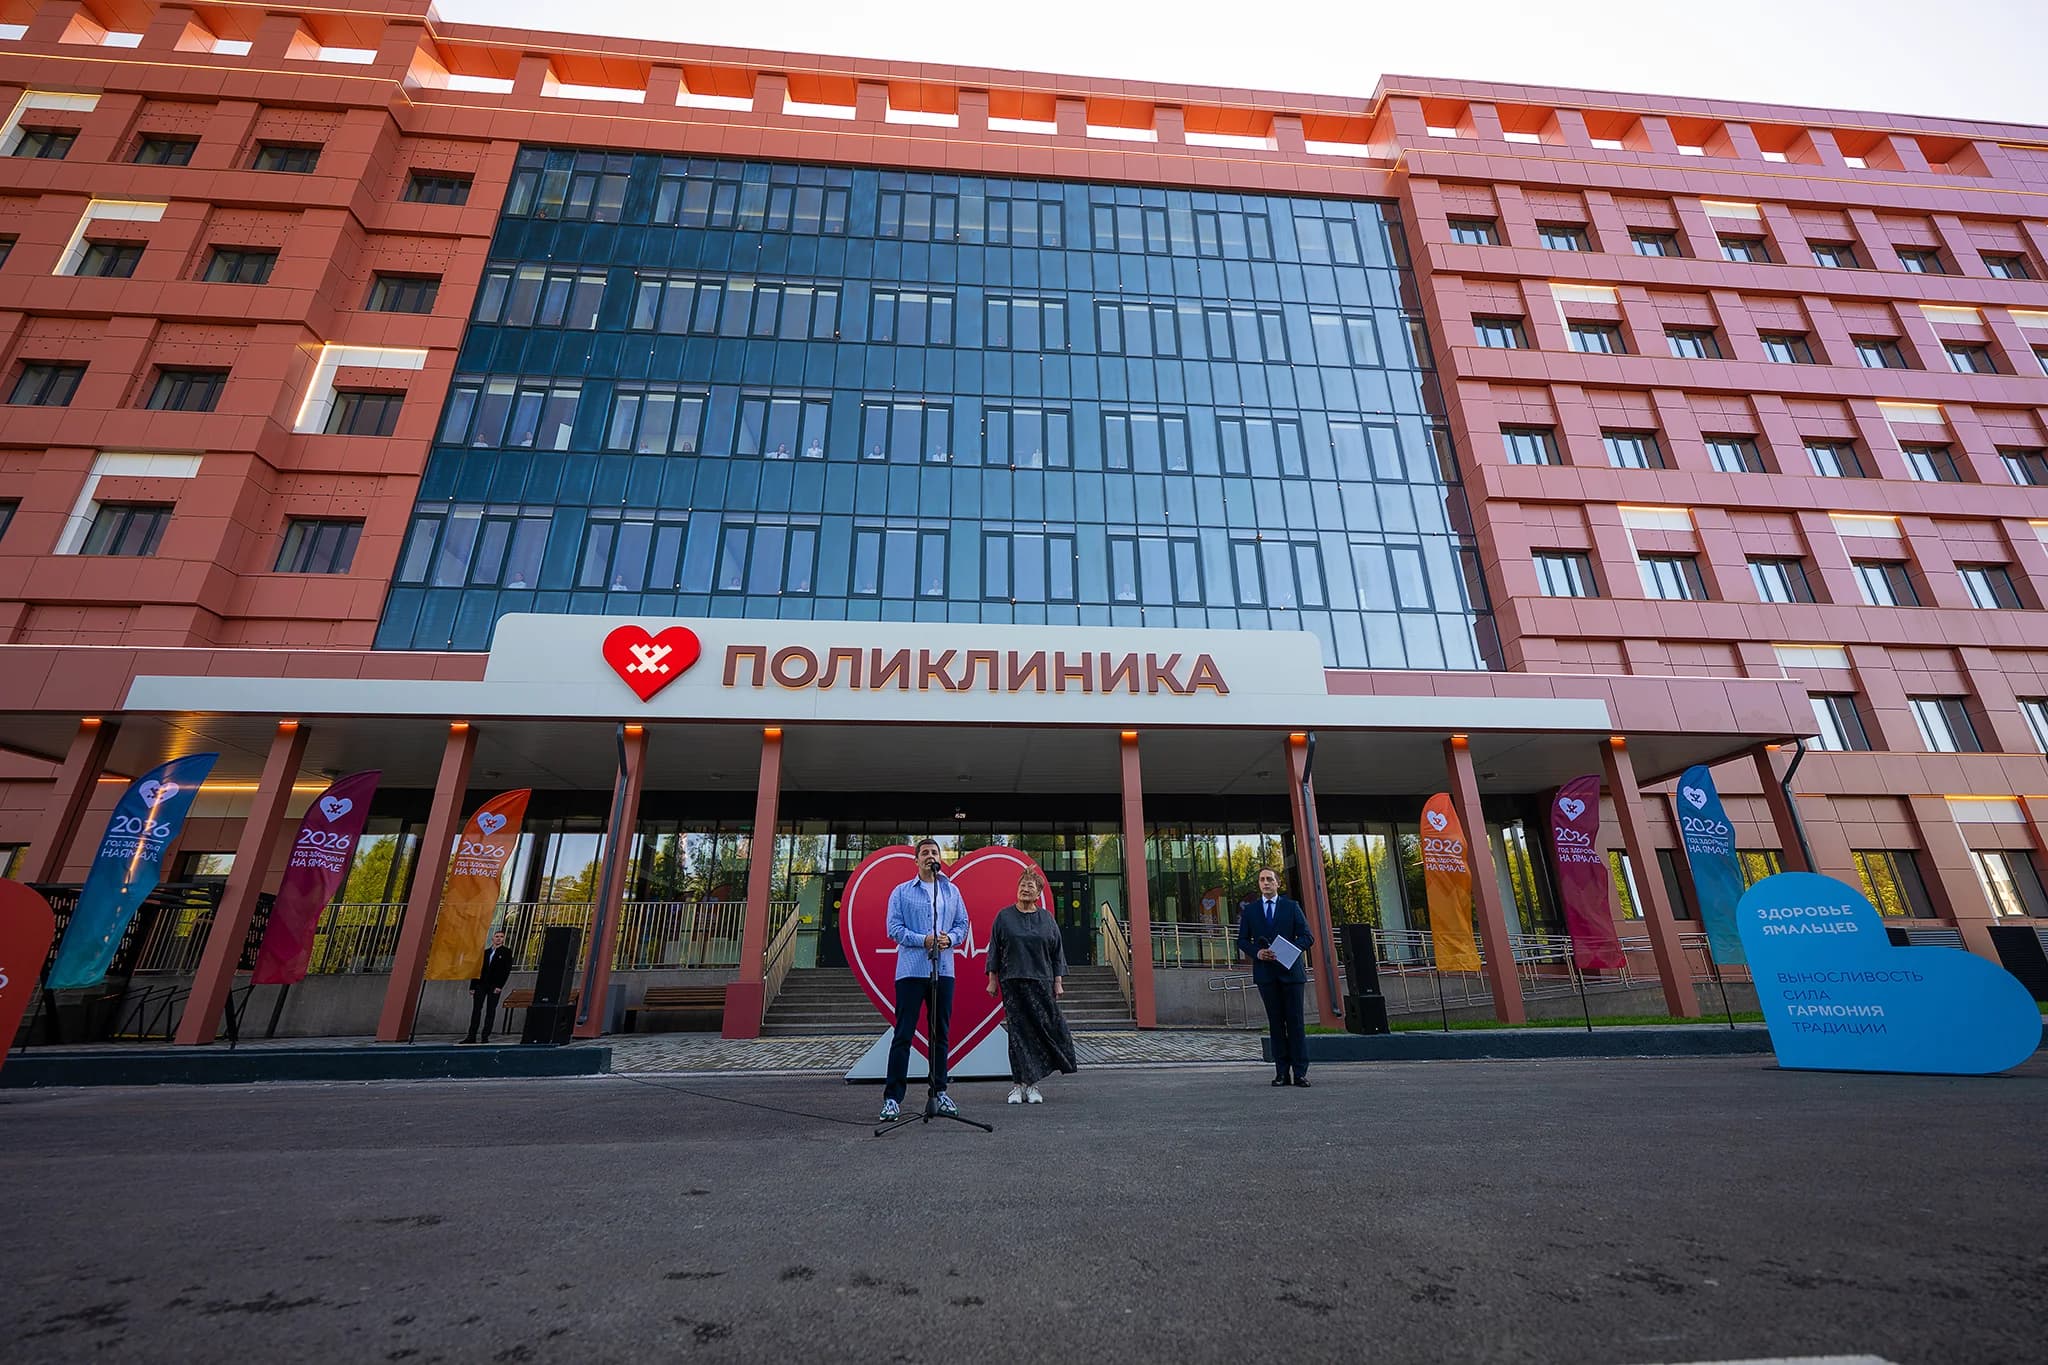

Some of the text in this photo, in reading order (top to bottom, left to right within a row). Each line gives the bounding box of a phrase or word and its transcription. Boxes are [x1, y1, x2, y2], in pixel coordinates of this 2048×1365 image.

[721, 645, 1230, 695] ПОЛИКЛИНИКА
[110, 815, 171, 838] 2026
[1683, 816, 1728, 835] 2026
[297, 828, 351, 850] 2026
[1555, 826, 1591, 847] 2026
[459, 840, 505, 858] 2026
[1423, 837, 1463, 855] 2026
[1688, 845, 1730, 857] НА ЯМАЛЕ
[101, 847, 158, 862] НА ЯМАЛЕ
[1559, 854, 1601, 864] НА ЯМАЛЕ
[290, 858, 342, 873] НА ЯМАЛЕ
[454, 867, 498, 878] НА ЯМАЛЕ
[1426, 863, 1466, 873] НА ЯМАЛЕ
[1757, 904, 1853, 921] ЗДОРОВЬЕ
[1762, 922, 1859, 936] ЯМАЛЬЦЕВ
[1776, 970, 1924, 984] ВЫНОСЛИВОСТЬ
[1783, 989, 1832, 1001] СИЛА
[1787, 1004, 1885, 1017] ГАРМОНИЯ
[1791, 1021, 1888, 1036] ТРАДИЦИИ
